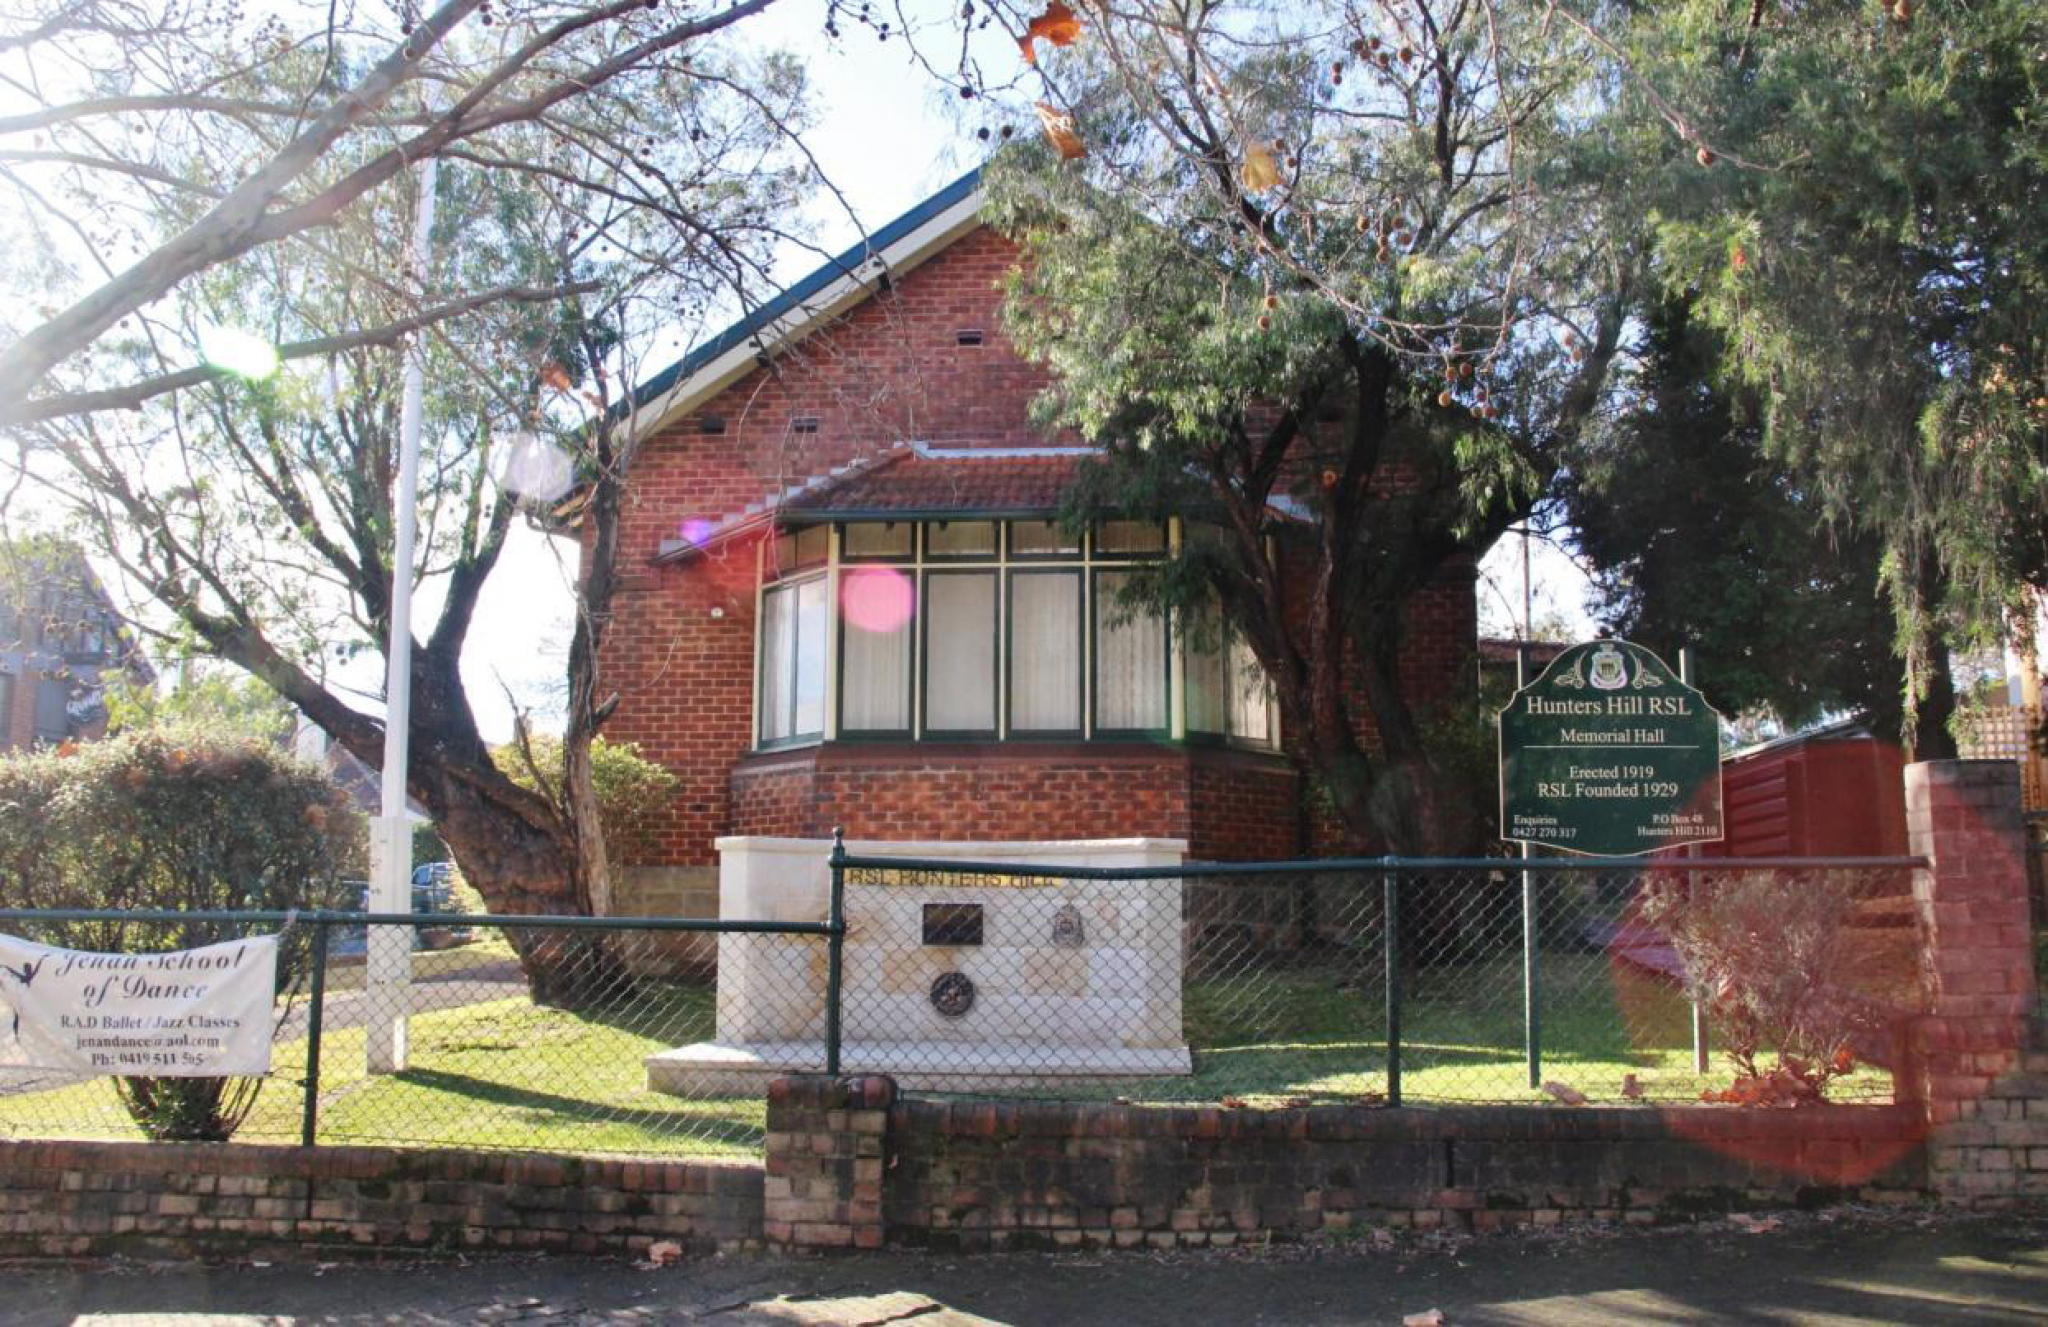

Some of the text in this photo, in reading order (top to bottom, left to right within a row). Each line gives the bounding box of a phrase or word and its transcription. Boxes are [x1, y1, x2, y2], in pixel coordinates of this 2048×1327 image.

[1526, 696, 1691, 715] Hunters Hill RSL
[1560, 728, 1664, 744] Memorial Hall
[1569, 766, 1654, 779] Erected 1919
[1538, 783, 1679, 798] RSL Founded 1929
[1514, 814, 1557, 826] Enquiries
[1513, 827, 1536, 837] 0427
[1637, 825, 1673, 836] Hunters
[1675, 826, 1693, 836] Hill
[850, 868, 890, 885] RSL
[83, 974, 209, 1008] of Dance
[102, 1015, 143, 1030] Ballet
[152, 1015, 184, 1029] Jazz
[188, 1014, 241, 1029] Classes
[76, 1033, 220, 1050] jenandance@aol.com
[91, 1052, 115, 1067] Ph:
[119, 1052, 150, 1066] 0419
